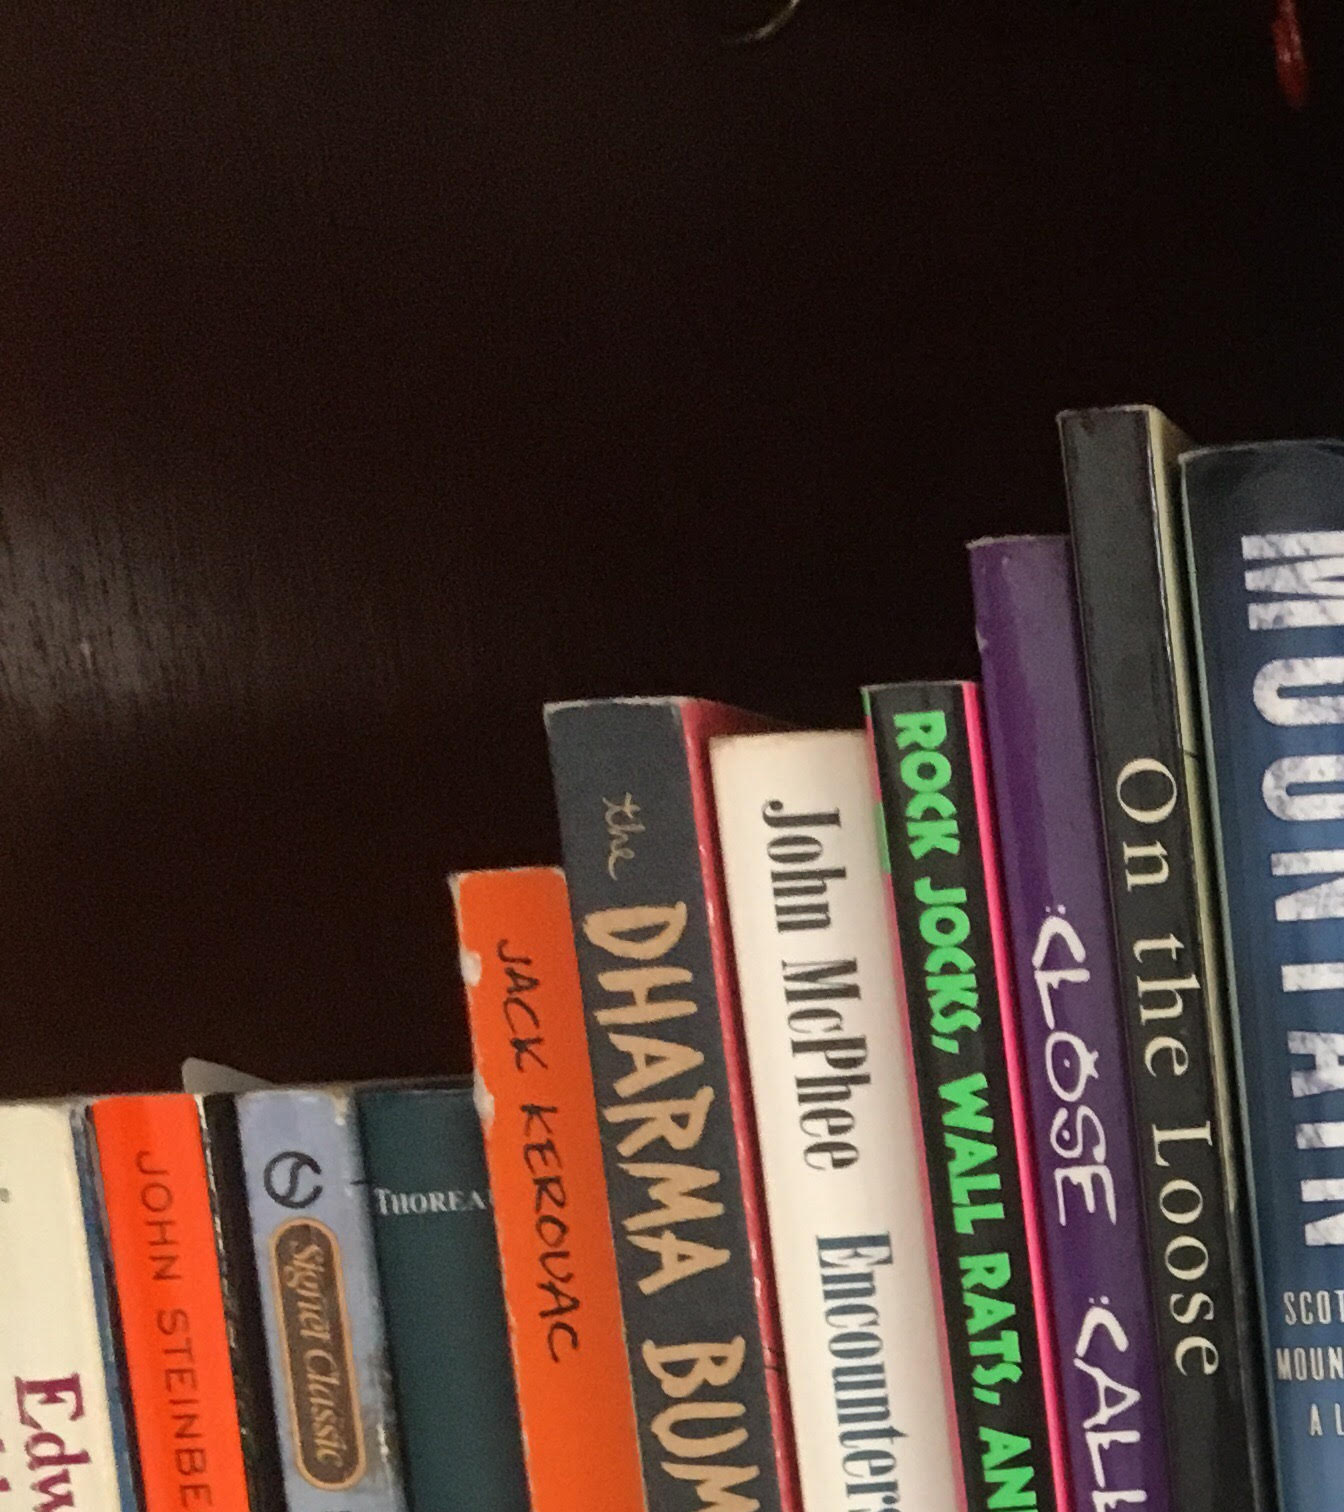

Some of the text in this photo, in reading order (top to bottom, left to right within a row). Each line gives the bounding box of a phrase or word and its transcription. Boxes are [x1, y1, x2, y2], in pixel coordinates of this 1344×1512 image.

[892, 710, 961, 859] ROCK
[762, 799, 871, 1170] John McPhee
[912, 876, 982, 1053] JOCKS,
[583, 900, 731, 1295] DHARMA
[1116, 757, 1219, 1375] On the Loose
[135, 1151, 179, 1281] JOHN
[938, 1072, 1005, 1234] WALL
[959, 1251, 1023, 1406] RATS,
[1308, 1404, 1321, 1437] A
